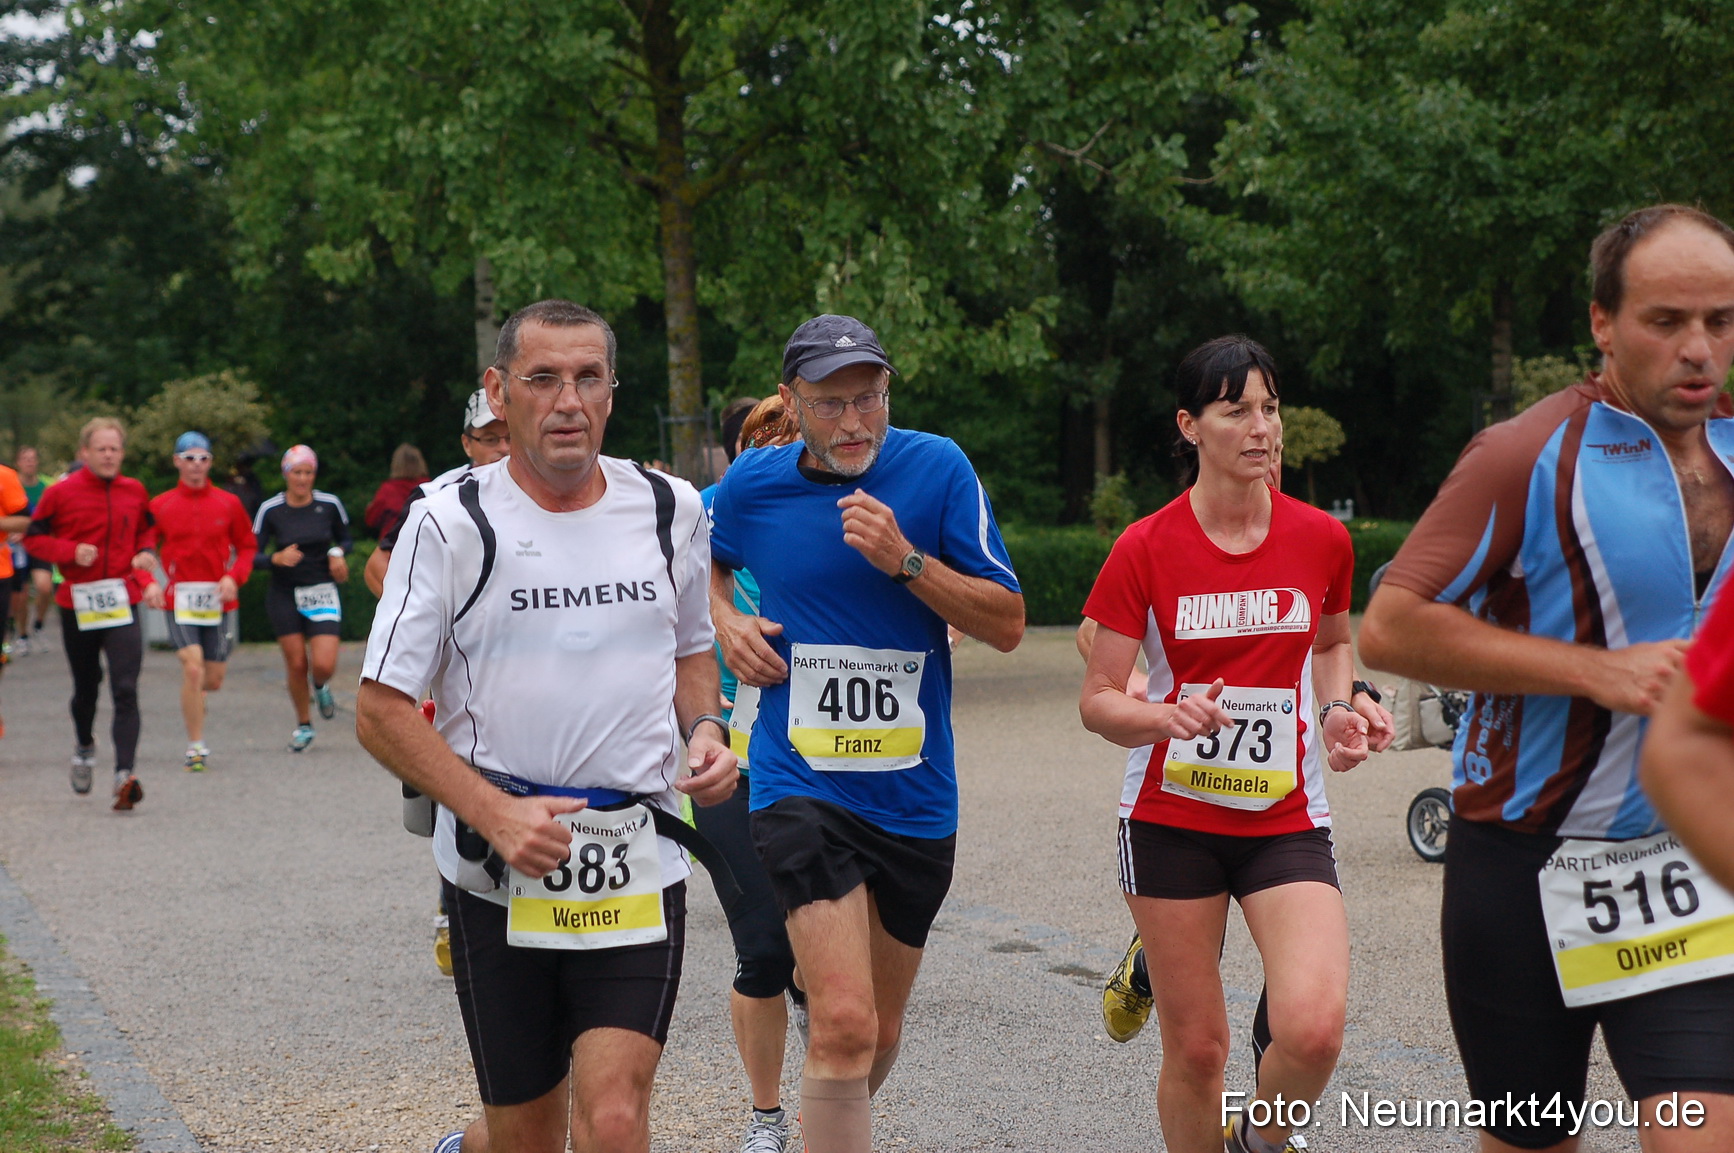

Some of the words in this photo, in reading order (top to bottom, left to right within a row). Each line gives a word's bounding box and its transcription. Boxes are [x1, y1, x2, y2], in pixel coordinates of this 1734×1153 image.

[510, 581, 657, 611] SIEMENS
[1238, 594, 1247, 626] COMPANY
[793, 656, 835, 670] PARTL
[839, 658, 899, 673] Neumarkt
[817, 676, 900, 723] 406
[1221, 699, 1277, 712] Neumarkt
[834, 735, 882, 753] Franz
[1172, 751, 1178, 760] C
[1196, 718, 1273, 763] 373
[1190, 770, 1269, 793] Michaela
[570, 820, 638, 838] Neumarkt
[542, 842, 631, 894] 383
[1543, 856, 1602, 872] PARTL
[1605, 836, 1682, 867] Neumark
[1583, 860, 1700, 934] 516
[552, 906, 622, 929] Werner
[1616, 937, 1688, 971] Oliver
